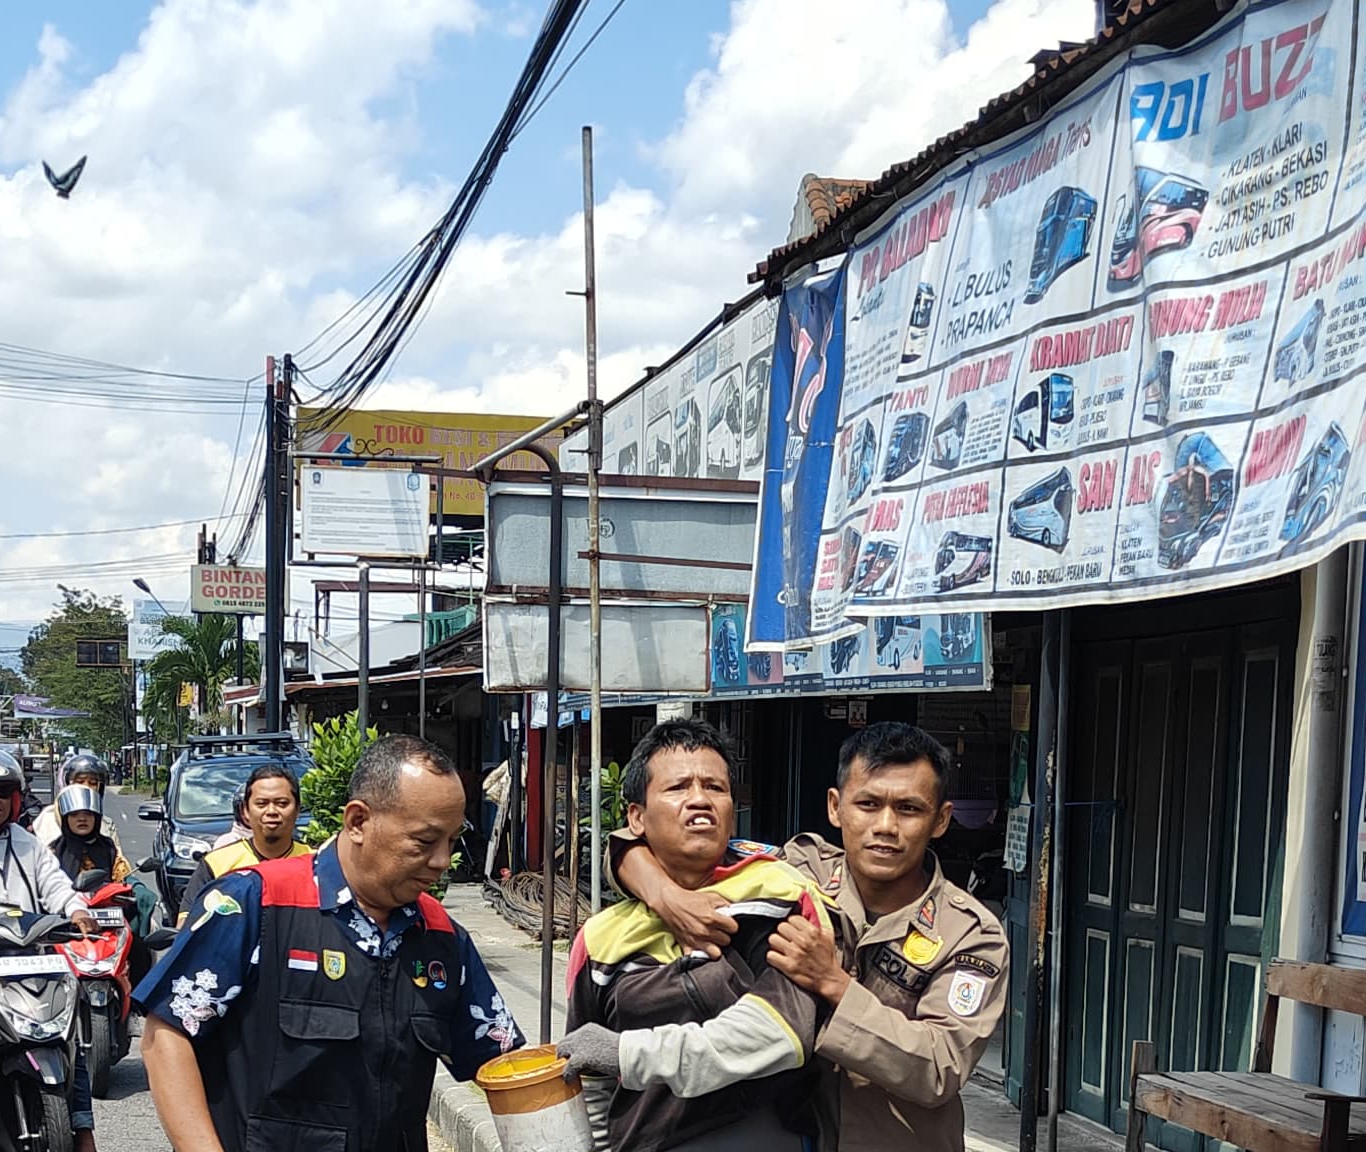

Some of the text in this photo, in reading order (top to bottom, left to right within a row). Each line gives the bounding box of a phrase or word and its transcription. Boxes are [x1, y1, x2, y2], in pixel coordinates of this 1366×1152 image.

[1227, 122, 1303, 178] KLATEN KLARI
[1221, 141, 1327, 207] CIKARANG BEKASI
[1295, 170, 1329, 200] REBO
[1261, 212, 1295, 242] PUTRI
[947, 298, 1016, 348] PRAPANCA
[1030, 325, 1097, 373] KRAMAT
[374, 425, 424, 445] TOKO
[1077, 456, 1118, 515] SAN
[202, 569, 266, 584] BINTAN
[1010, 569, 1031, 585] SOLO
[202, 585, 266, 600] GORDE
